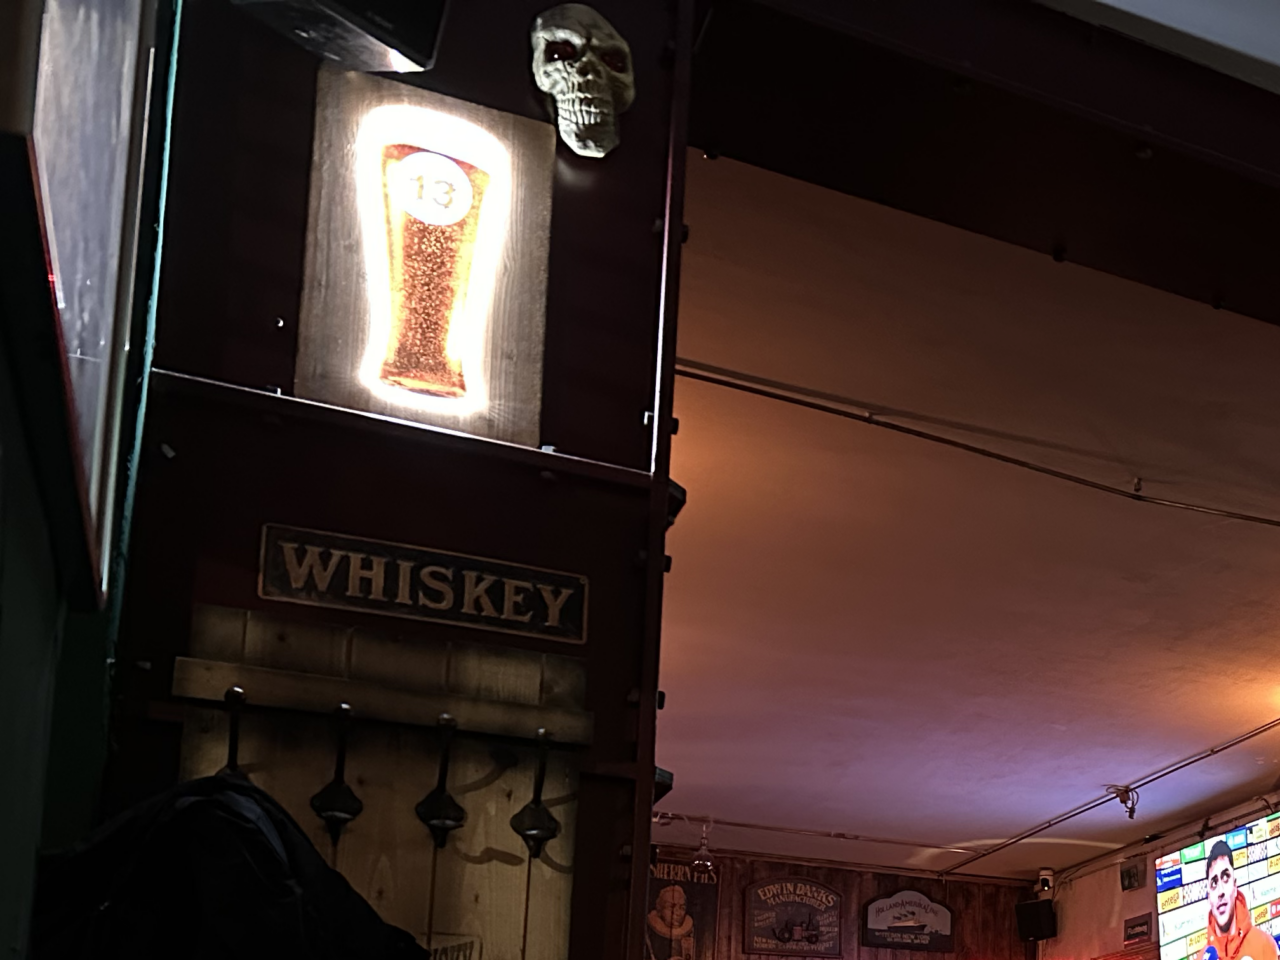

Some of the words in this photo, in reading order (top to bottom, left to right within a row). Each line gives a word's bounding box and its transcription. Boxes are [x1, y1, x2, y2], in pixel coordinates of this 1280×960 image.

[410, 175, 456, 209] 13
[277, 540, 575, 628] WHISKEY
[757, 882, 794, 900] EDWIN
[796, 883, 836, 907] DANKS
[766, 894, 826, 911] MANUFACTURER
